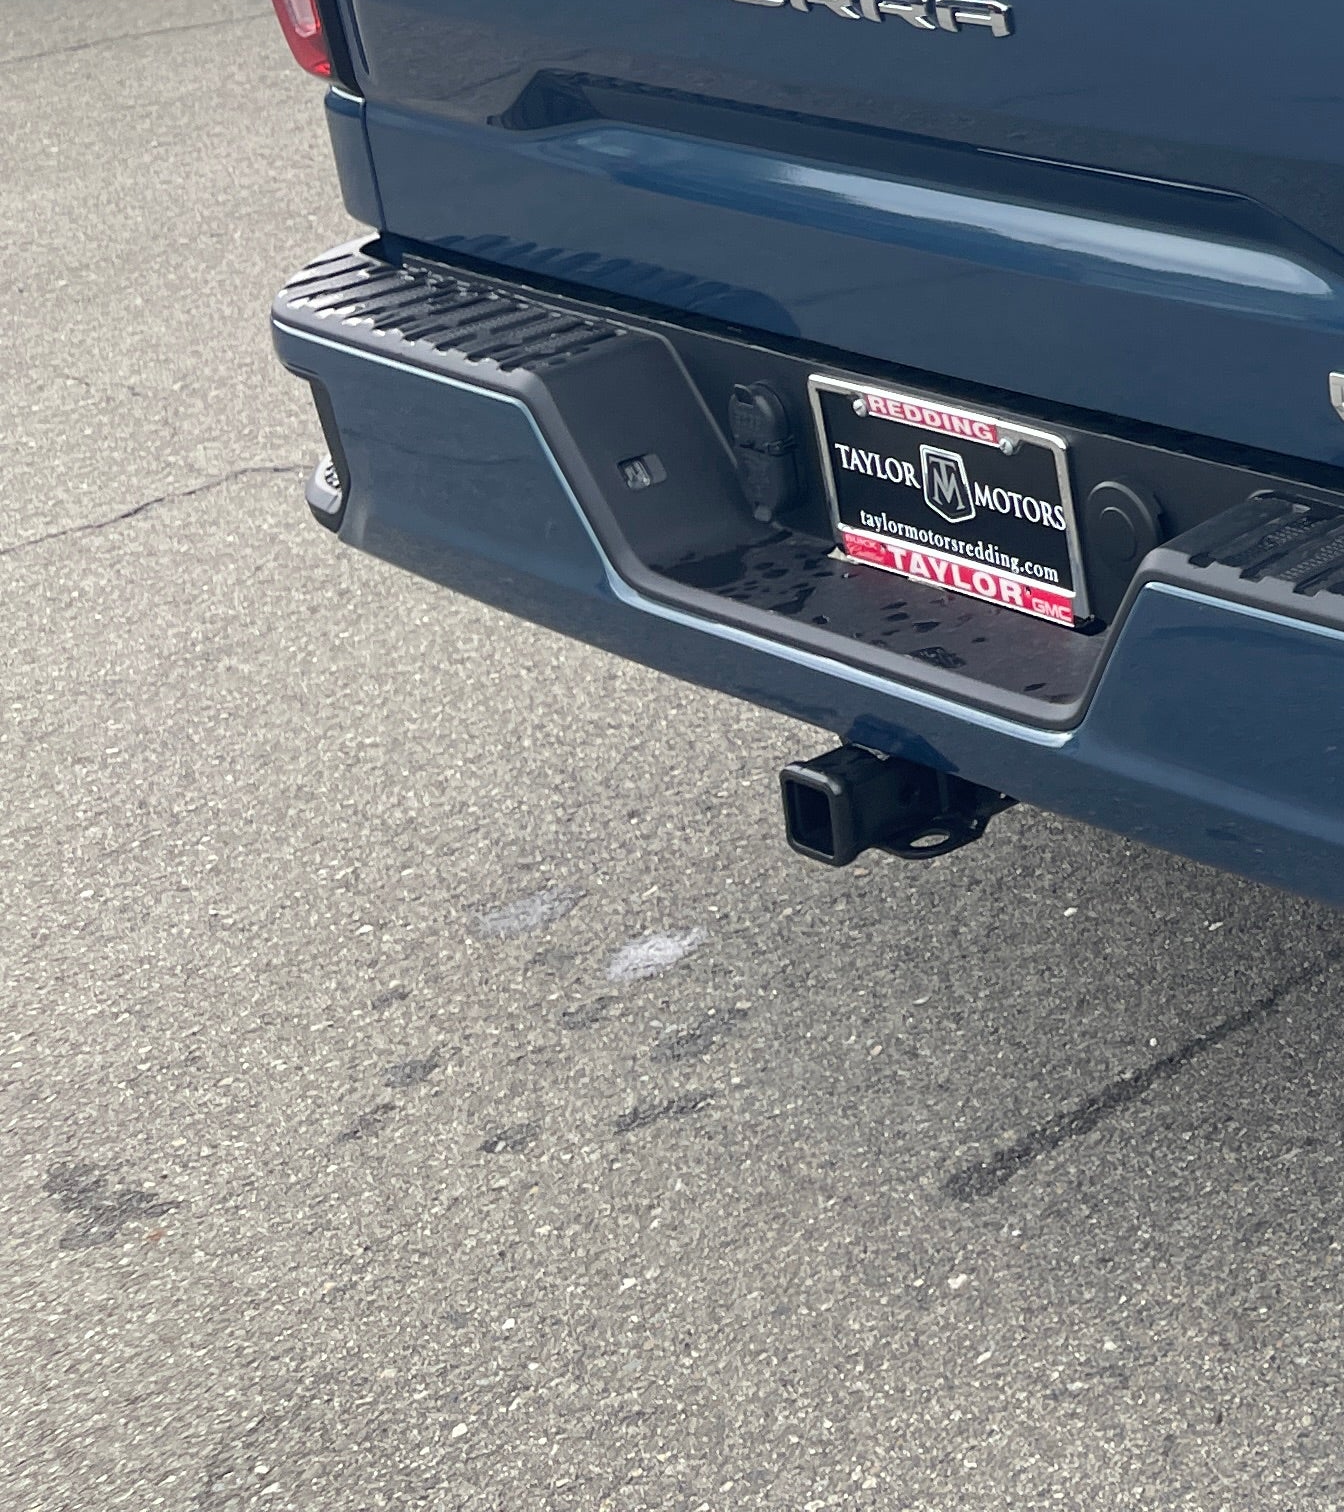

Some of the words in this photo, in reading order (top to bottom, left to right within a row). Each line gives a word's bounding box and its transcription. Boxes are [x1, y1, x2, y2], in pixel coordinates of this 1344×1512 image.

[866, 395, 995, 440] REDDING
[835, 443, 921, 489] TAYLOR
[973, 481, 1067, 531] MOTORS
[860, 509, 1059, 583] taylormotorsredding.com
[885, 544, 1024, 607] TAYLOR
[1032, 599, 1073, 623] GMC
